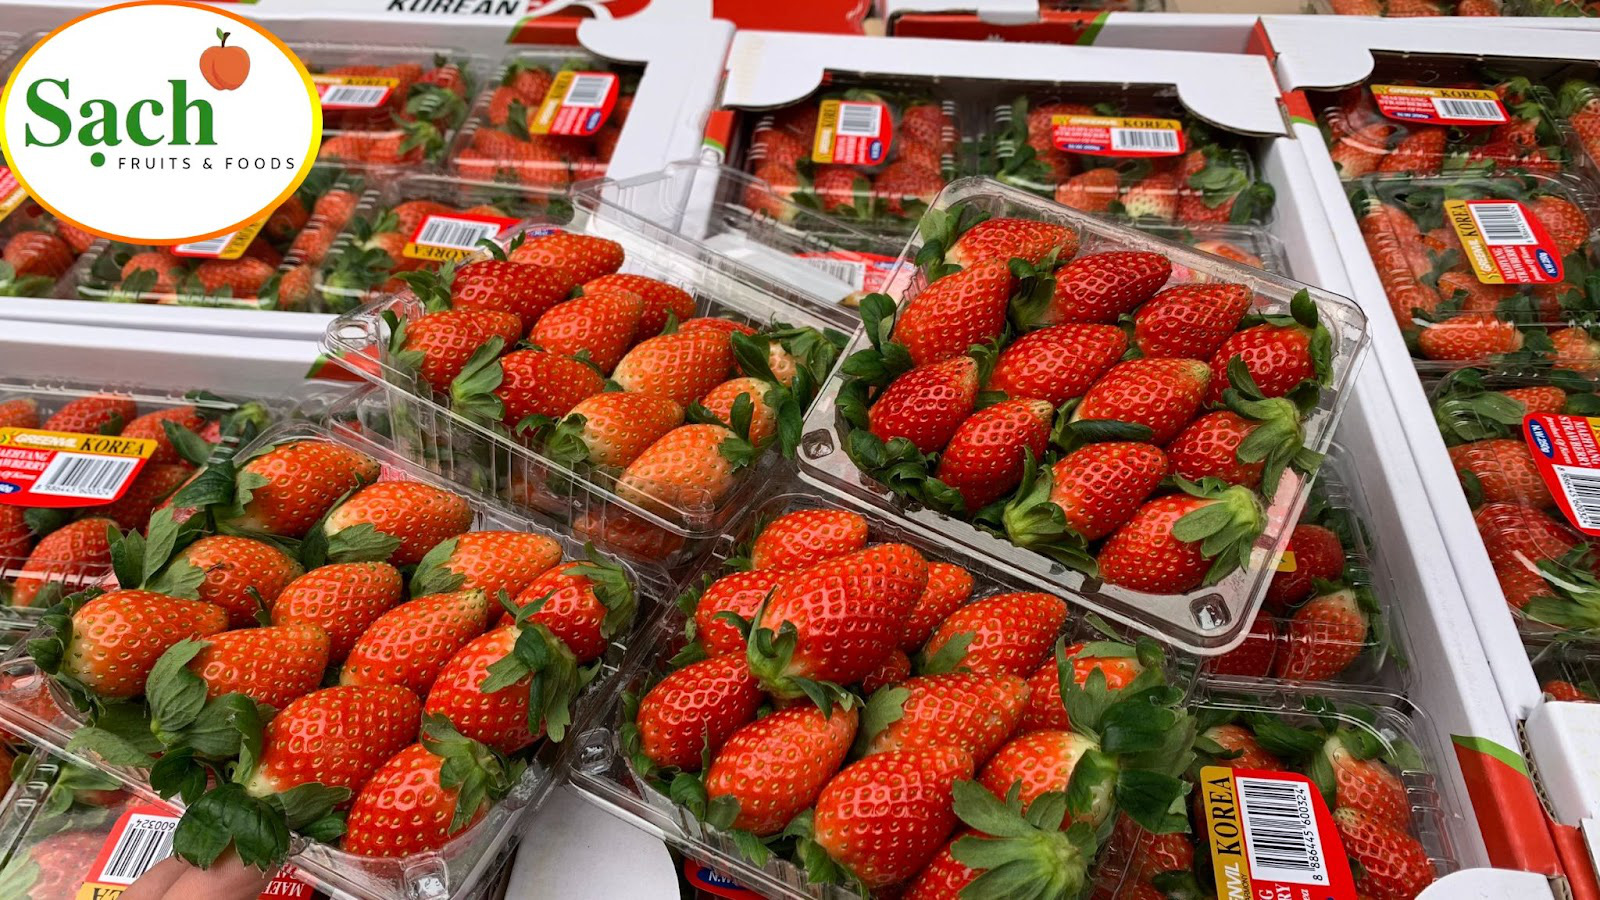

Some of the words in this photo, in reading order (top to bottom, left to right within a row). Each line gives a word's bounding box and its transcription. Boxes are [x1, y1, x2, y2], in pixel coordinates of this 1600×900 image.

[1440, 90, 1492, 99] KOREA
[1123, 120, 1174, 129] KOREA
[1451, 204, 1479, 237] KOREA
[413, 246, 470, 261] KOREA
[1501, 245, 1532, 283] STRAWBERRY
[80, 437, 145, 456] KOREA
[1558, 415, 1592, 468] STRAWBERRY
[0, 448, 50, 461] AEHYANG
[1207, 776, 1243, 857] KOREA
[1294, 788, 1311, 826] 600324
[135, 819, 175, 831] 600324
[1304, 830, 1320, 869] 886445
[262, 880, 305, 897] MAE
